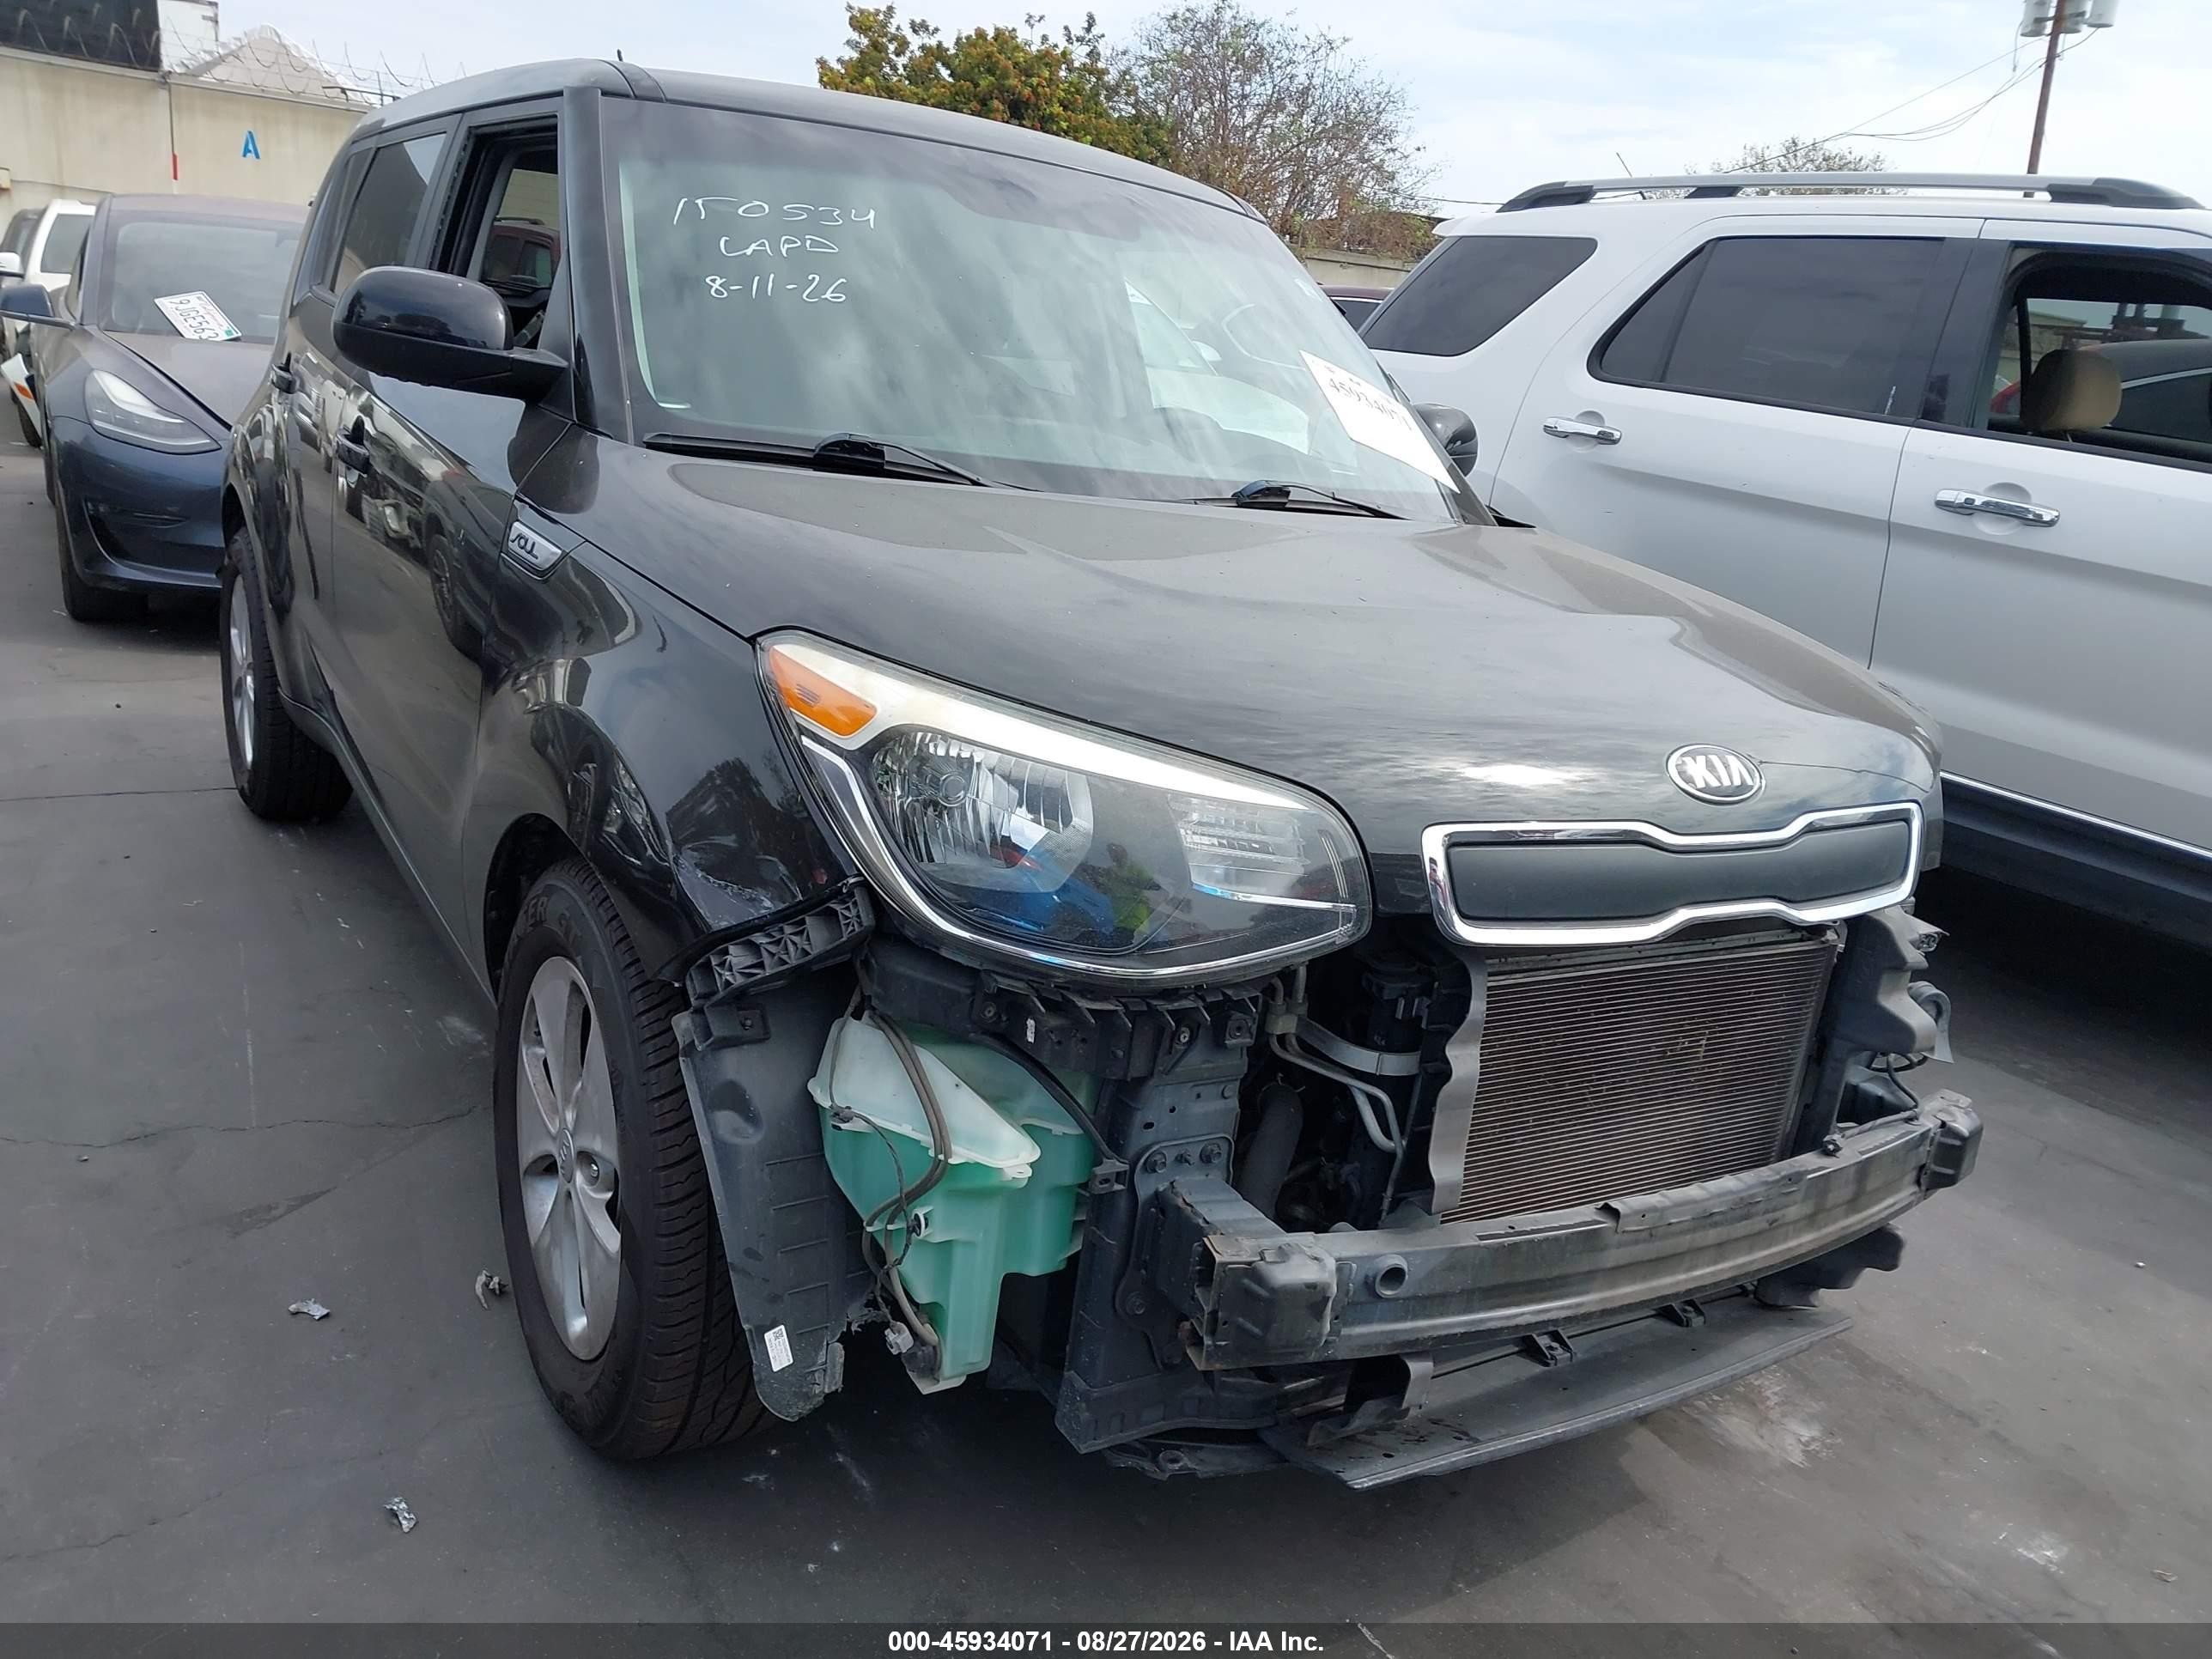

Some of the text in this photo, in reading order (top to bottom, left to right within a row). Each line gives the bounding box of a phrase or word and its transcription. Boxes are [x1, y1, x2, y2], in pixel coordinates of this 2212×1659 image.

[242, 131, 261, 160] A
[719, 234, 840, 258] LAPD
[704, 273, 848, 302] 8-11-26
[1680, 754, 1755, 789] KIA
